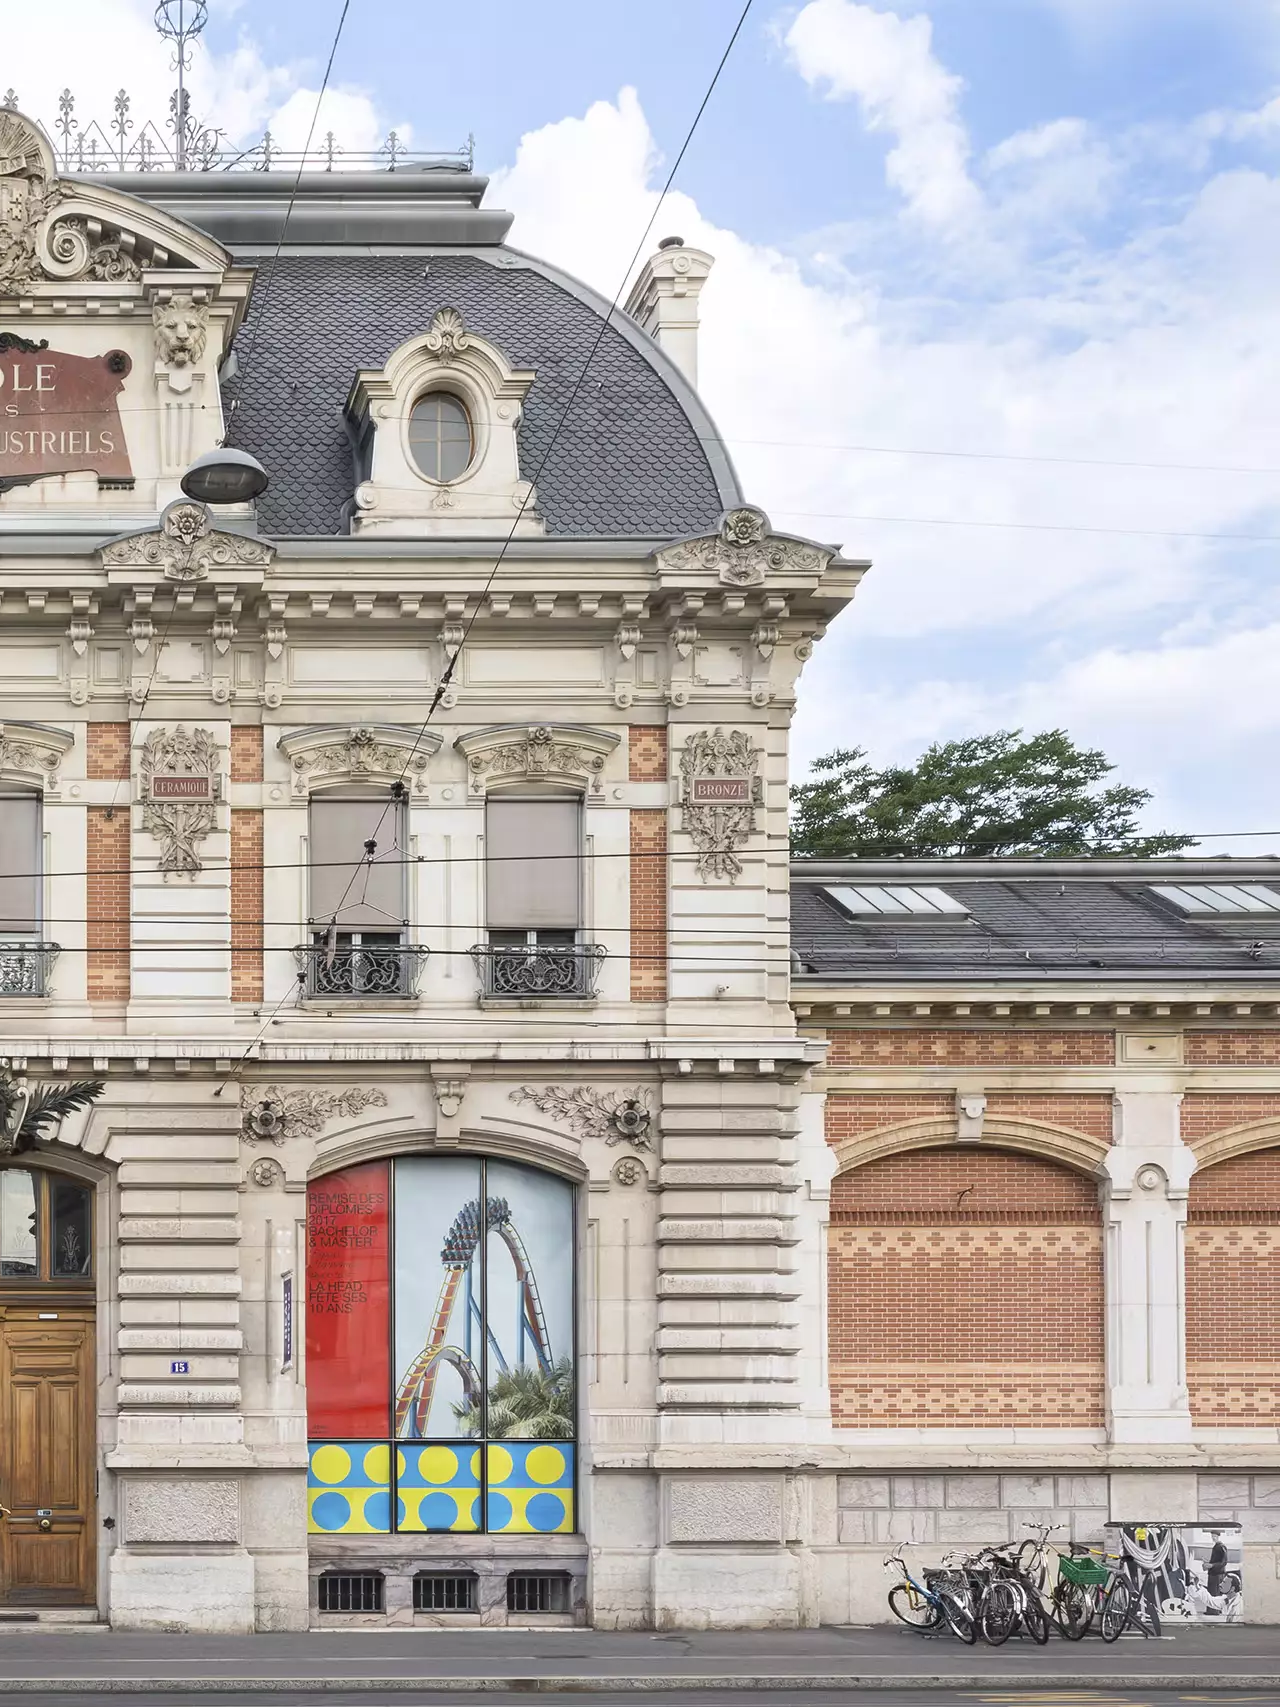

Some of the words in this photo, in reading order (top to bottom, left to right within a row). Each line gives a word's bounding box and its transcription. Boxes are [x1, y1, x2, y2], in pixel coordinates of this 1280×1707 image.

[154, 781, 208, 794] CERAMIQUE
[697, 784, 745, 796] BRONZE
[308, 1193, 357, 1204] REMISE
[359, 1193, 386, 1204] DES
[308, 1215, 337, 1225] 2017
[309, 1225, 378, 1237] BACHELOR
[320, 1236, 373, 1247] MASTER
[309, 1281, 325, 1292] LA
[328, 1281, 363, 1292] HEAD
[343, 1292, 368, 1303] SES
[310, 1303, 324, 1314] 10
[326, 1303, 353, 1314] ANS
[174, 1362, 185, 1373] 15
